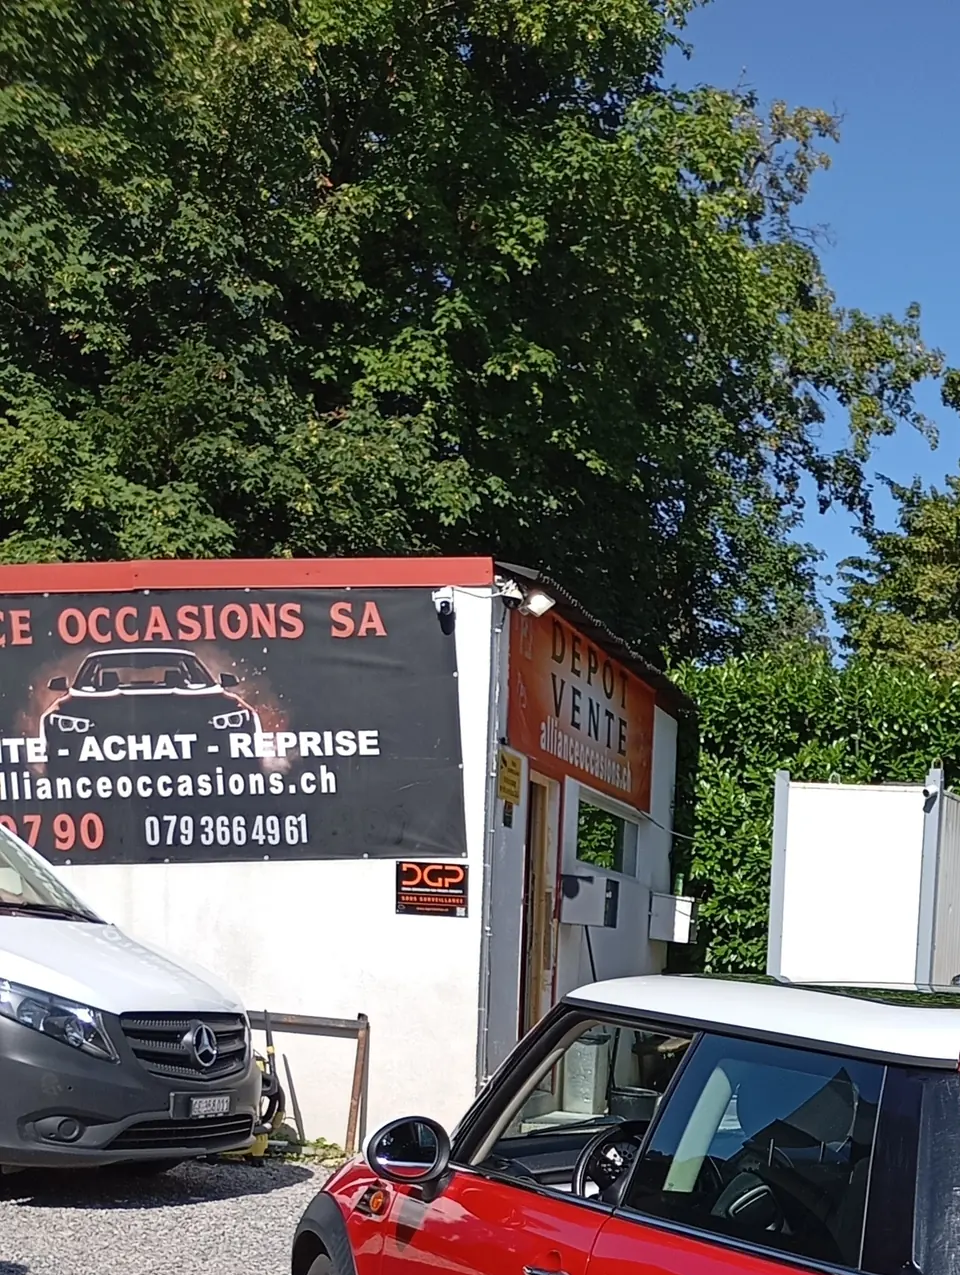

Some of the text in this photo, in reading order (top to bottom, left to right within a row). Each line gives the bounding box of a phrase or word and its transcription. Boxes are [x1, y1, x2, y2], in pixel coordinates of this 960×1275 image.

[0, 601, 387, 646] E OCCASIONS SA
[551, 617, 629, 709] DEPOT
[551, 672, 627, 757] VENTE
[0, 737, 48, 763] TE
[79, 733, 197, 761] ACHAT
[229, 729, 380, 758] REPRISE
[540, 715, 631, 793] allianceoccasions.ch
[53, 812, 104, 850] 90
[145, 813, 308, 846] 079 366 49 61
[402, 863, 464, 888] DGP
